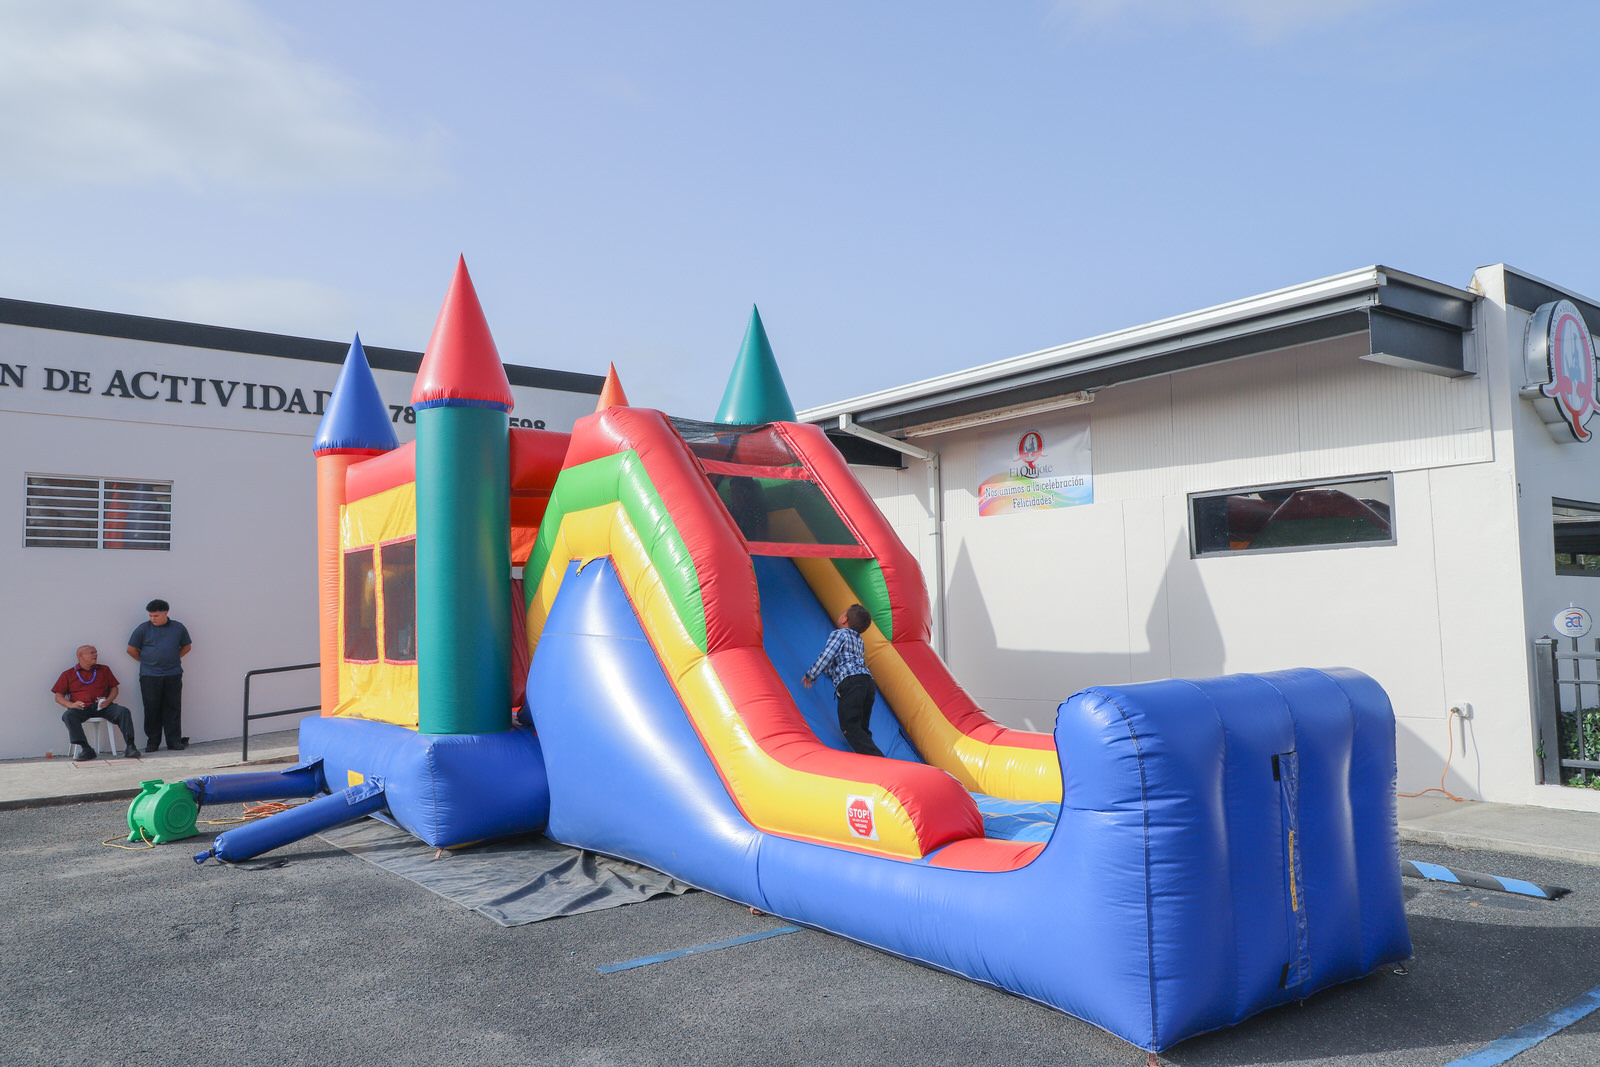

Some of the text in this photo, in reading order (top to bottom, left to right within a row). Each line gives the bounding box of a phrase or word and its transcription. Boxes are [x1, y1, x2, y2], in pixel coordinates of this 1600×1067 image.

[43, 368, 92, 394] DE
[1009, 464, 1053, 479] El Quijote
[985, 487, 998, 498] Nos
[1000, 485, 1025, 496] unimos
[1032, 481, 1040, 492] la
[1041, 475, 1085, 490] celebración
[1012, 494, 1055, 509] Felicidades!
[848, 808, 870, 820] STOP!
